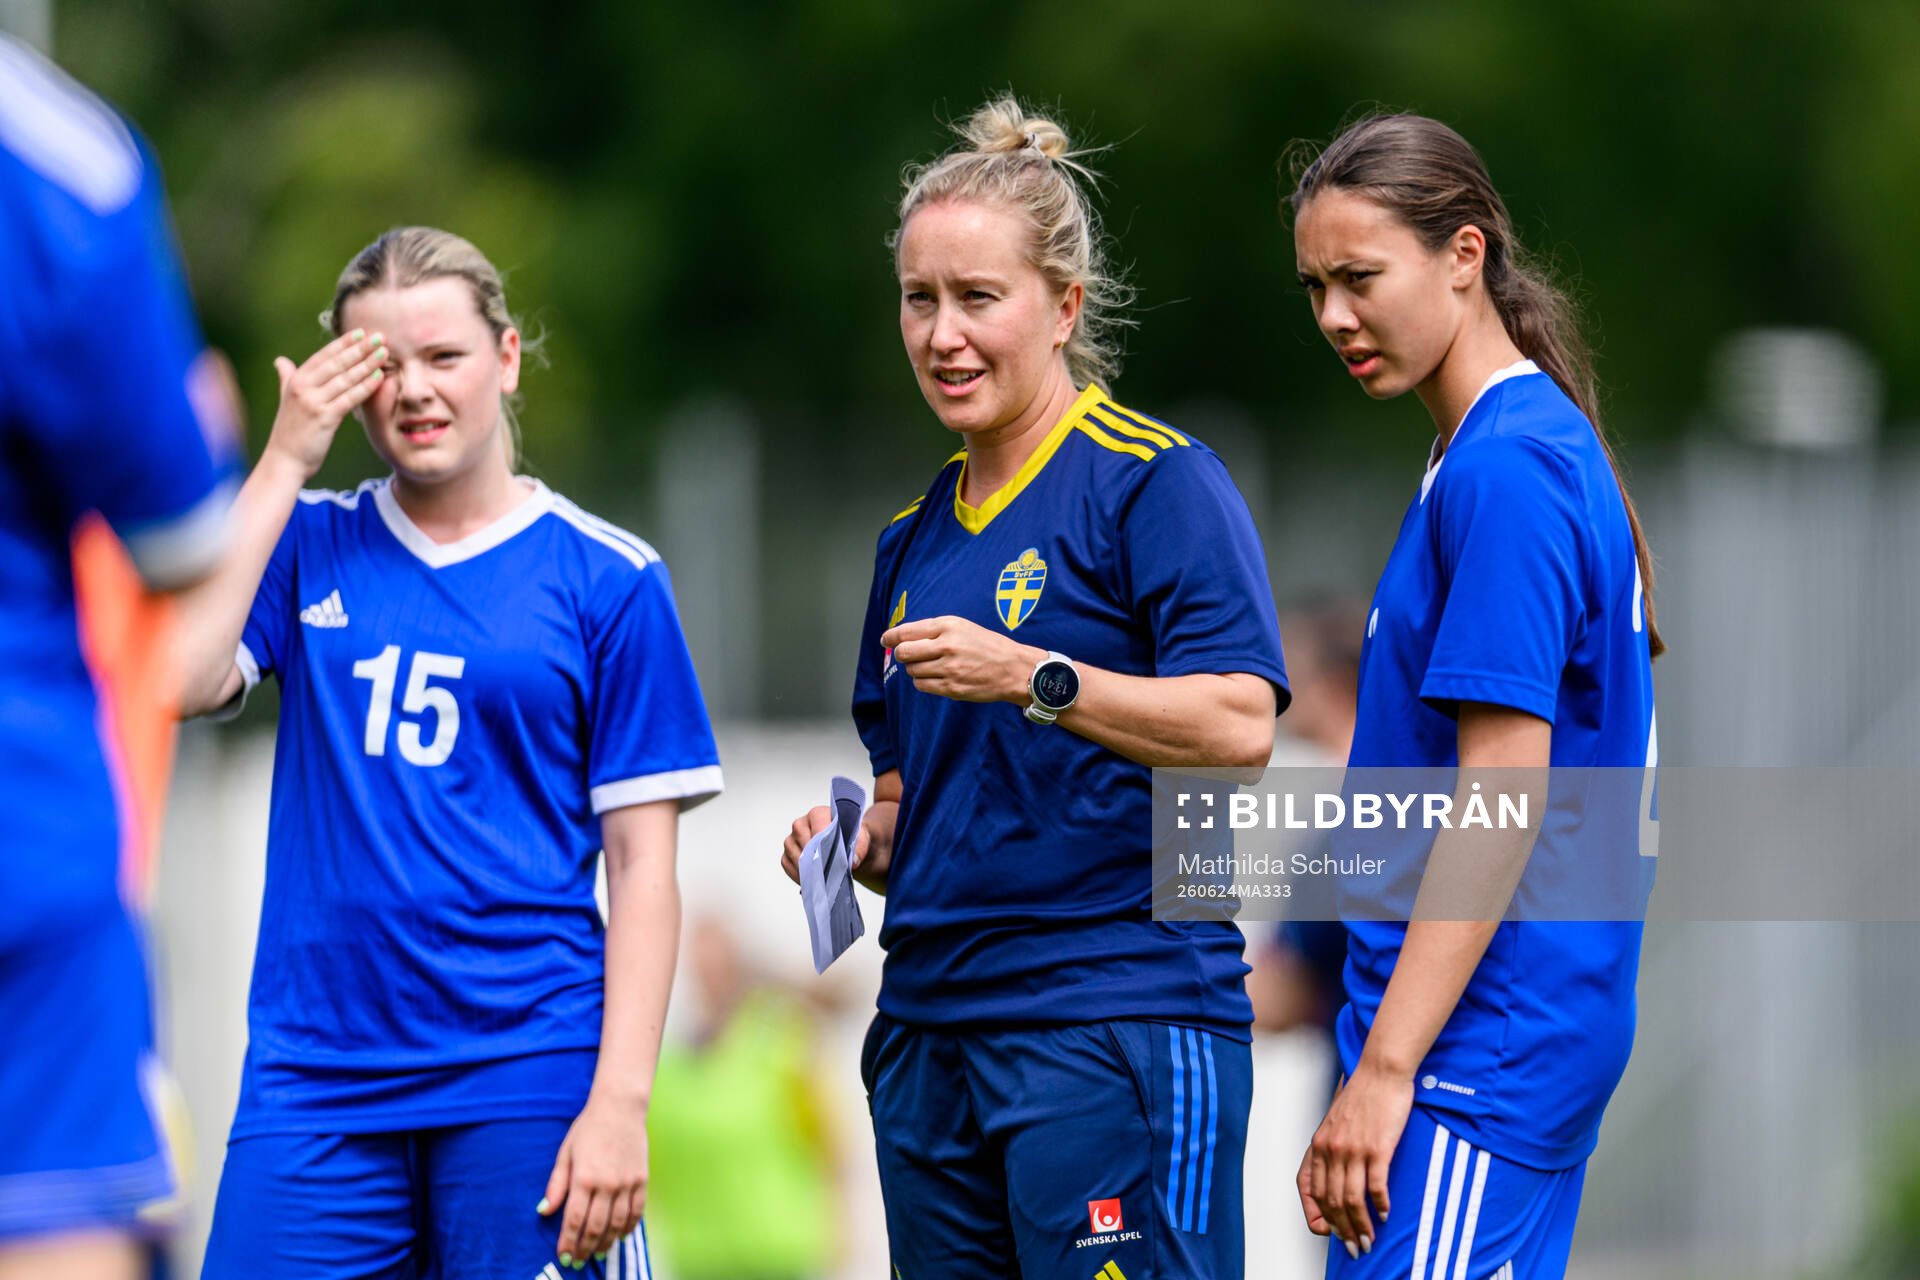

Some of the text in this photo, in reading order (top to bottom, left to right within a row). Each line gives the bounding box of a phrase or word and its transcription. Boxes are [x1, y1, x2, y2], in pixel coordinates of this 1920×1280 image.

[353, 645, 465, 767] 15
[1076, 1231, 1142, 1249] SVENSKA SPEL
